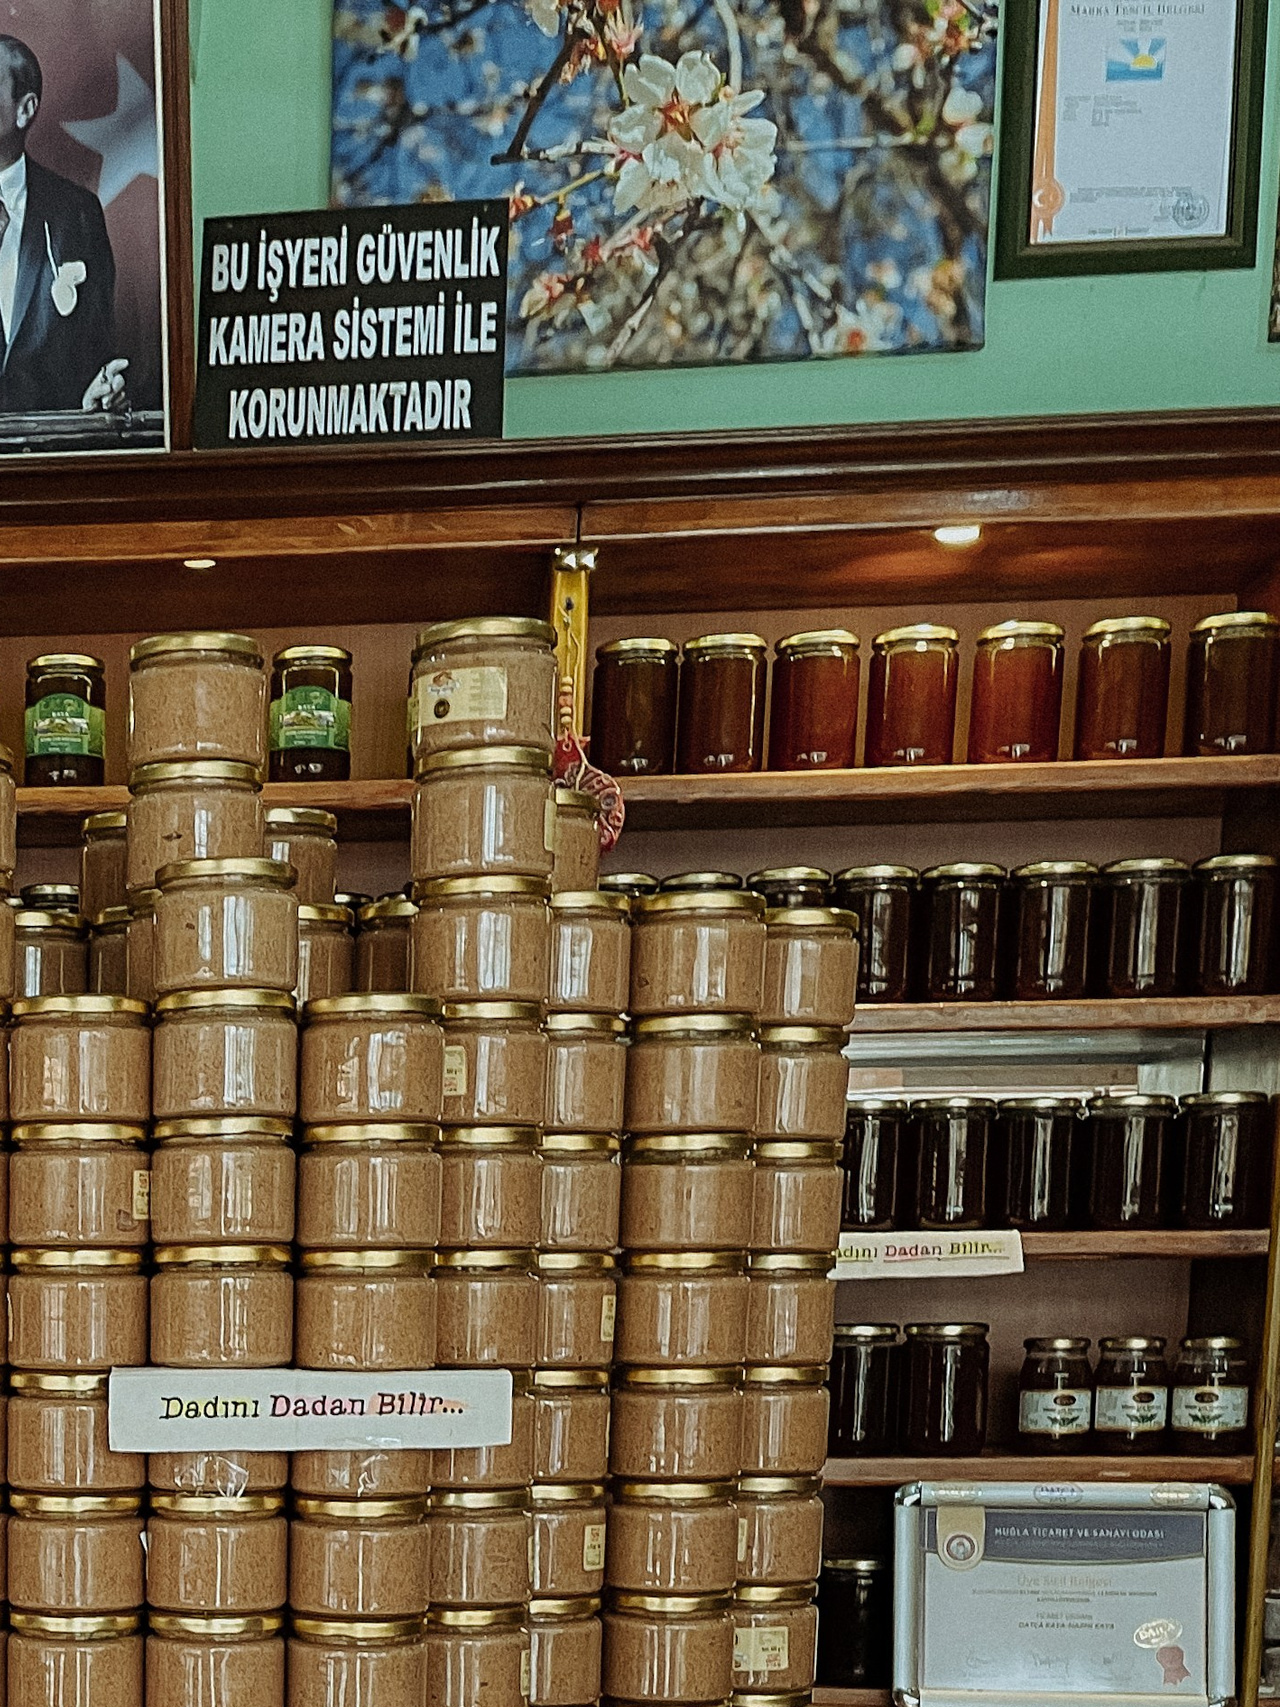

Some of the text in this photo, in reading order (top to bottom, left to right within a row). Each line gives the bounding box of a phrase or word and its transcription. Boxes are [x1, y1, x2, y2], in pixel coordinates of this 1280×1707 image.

[211, 217, 502, 302] BU İŞYERİ GÜVENLİK
[208, 290, 497, 366] KAMERA SİSTEMİ İLE
[228, 379, 472, 440] KORUNMAKTADIR
[885, 1244, 942, 1258] Dadan
[158, 1396, 261, 1420] Dadını
[270, 1394, 365, 1416] Dadan
